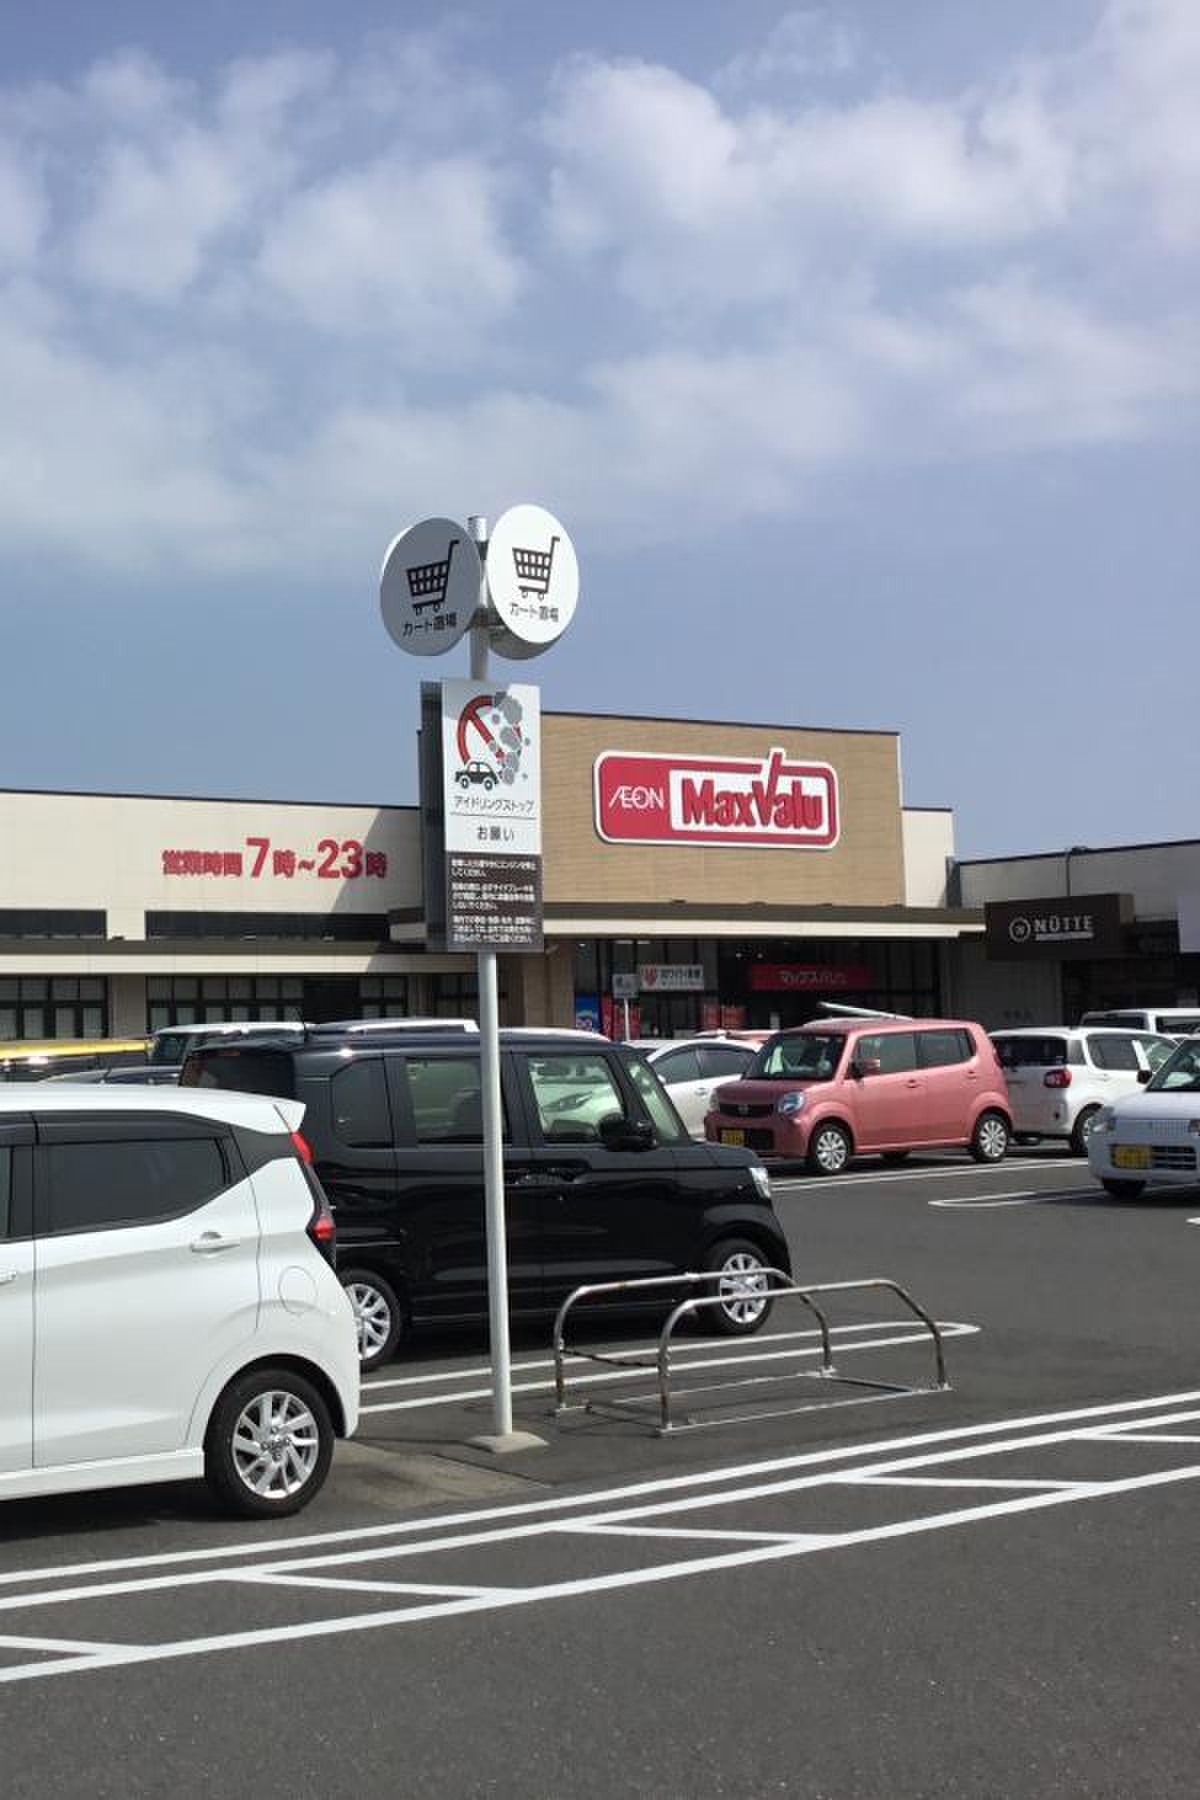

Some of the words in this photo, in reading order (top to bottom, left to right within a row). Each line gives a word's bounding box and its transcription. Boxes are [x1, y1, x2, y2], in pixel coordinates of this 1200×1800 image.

[508, 601, 560, 622] カート置場
[402, 612, 458, 637] カート置場
[681, 752, 824, 830] MaxValu
[453, 795, 535, 815] アイドリングストップ
[477, 825, 515, 842] お願い
